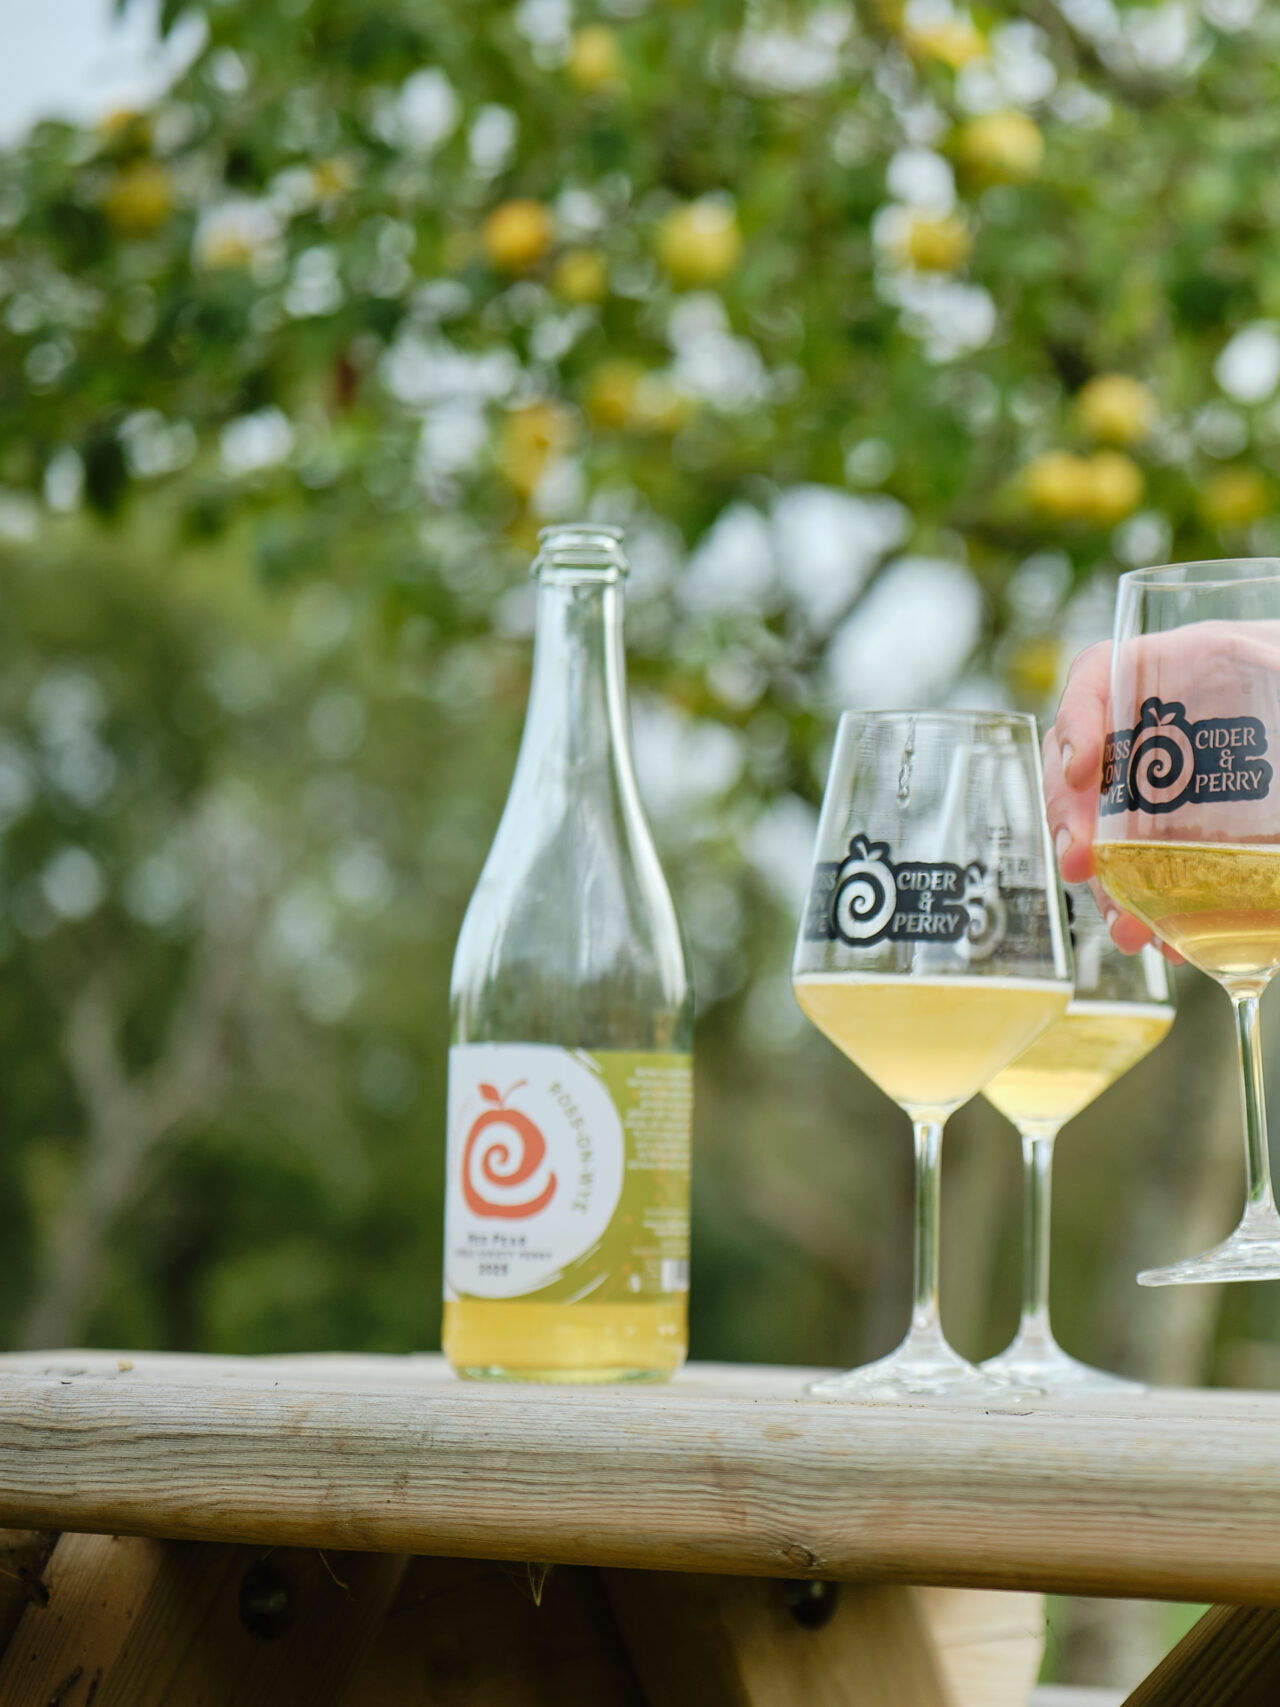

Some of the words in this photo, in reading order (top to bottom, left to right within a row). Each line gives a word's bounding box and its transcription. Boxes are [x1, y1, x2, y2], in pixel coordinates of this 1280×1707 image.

[1195, 727, 1256, 749] CIDER
[1219, 749, 1235, 771] &
[1106, 763, 1122, 784] ON
[1194, 770, 1263, 794] PERRY
[897, 870, 957, 891] CIDER
[918, 890, 935, 911] &
[893, 913, 960, 934] PERRY
[549, 1080, 593, 1215] ROSS-ON-WYE
